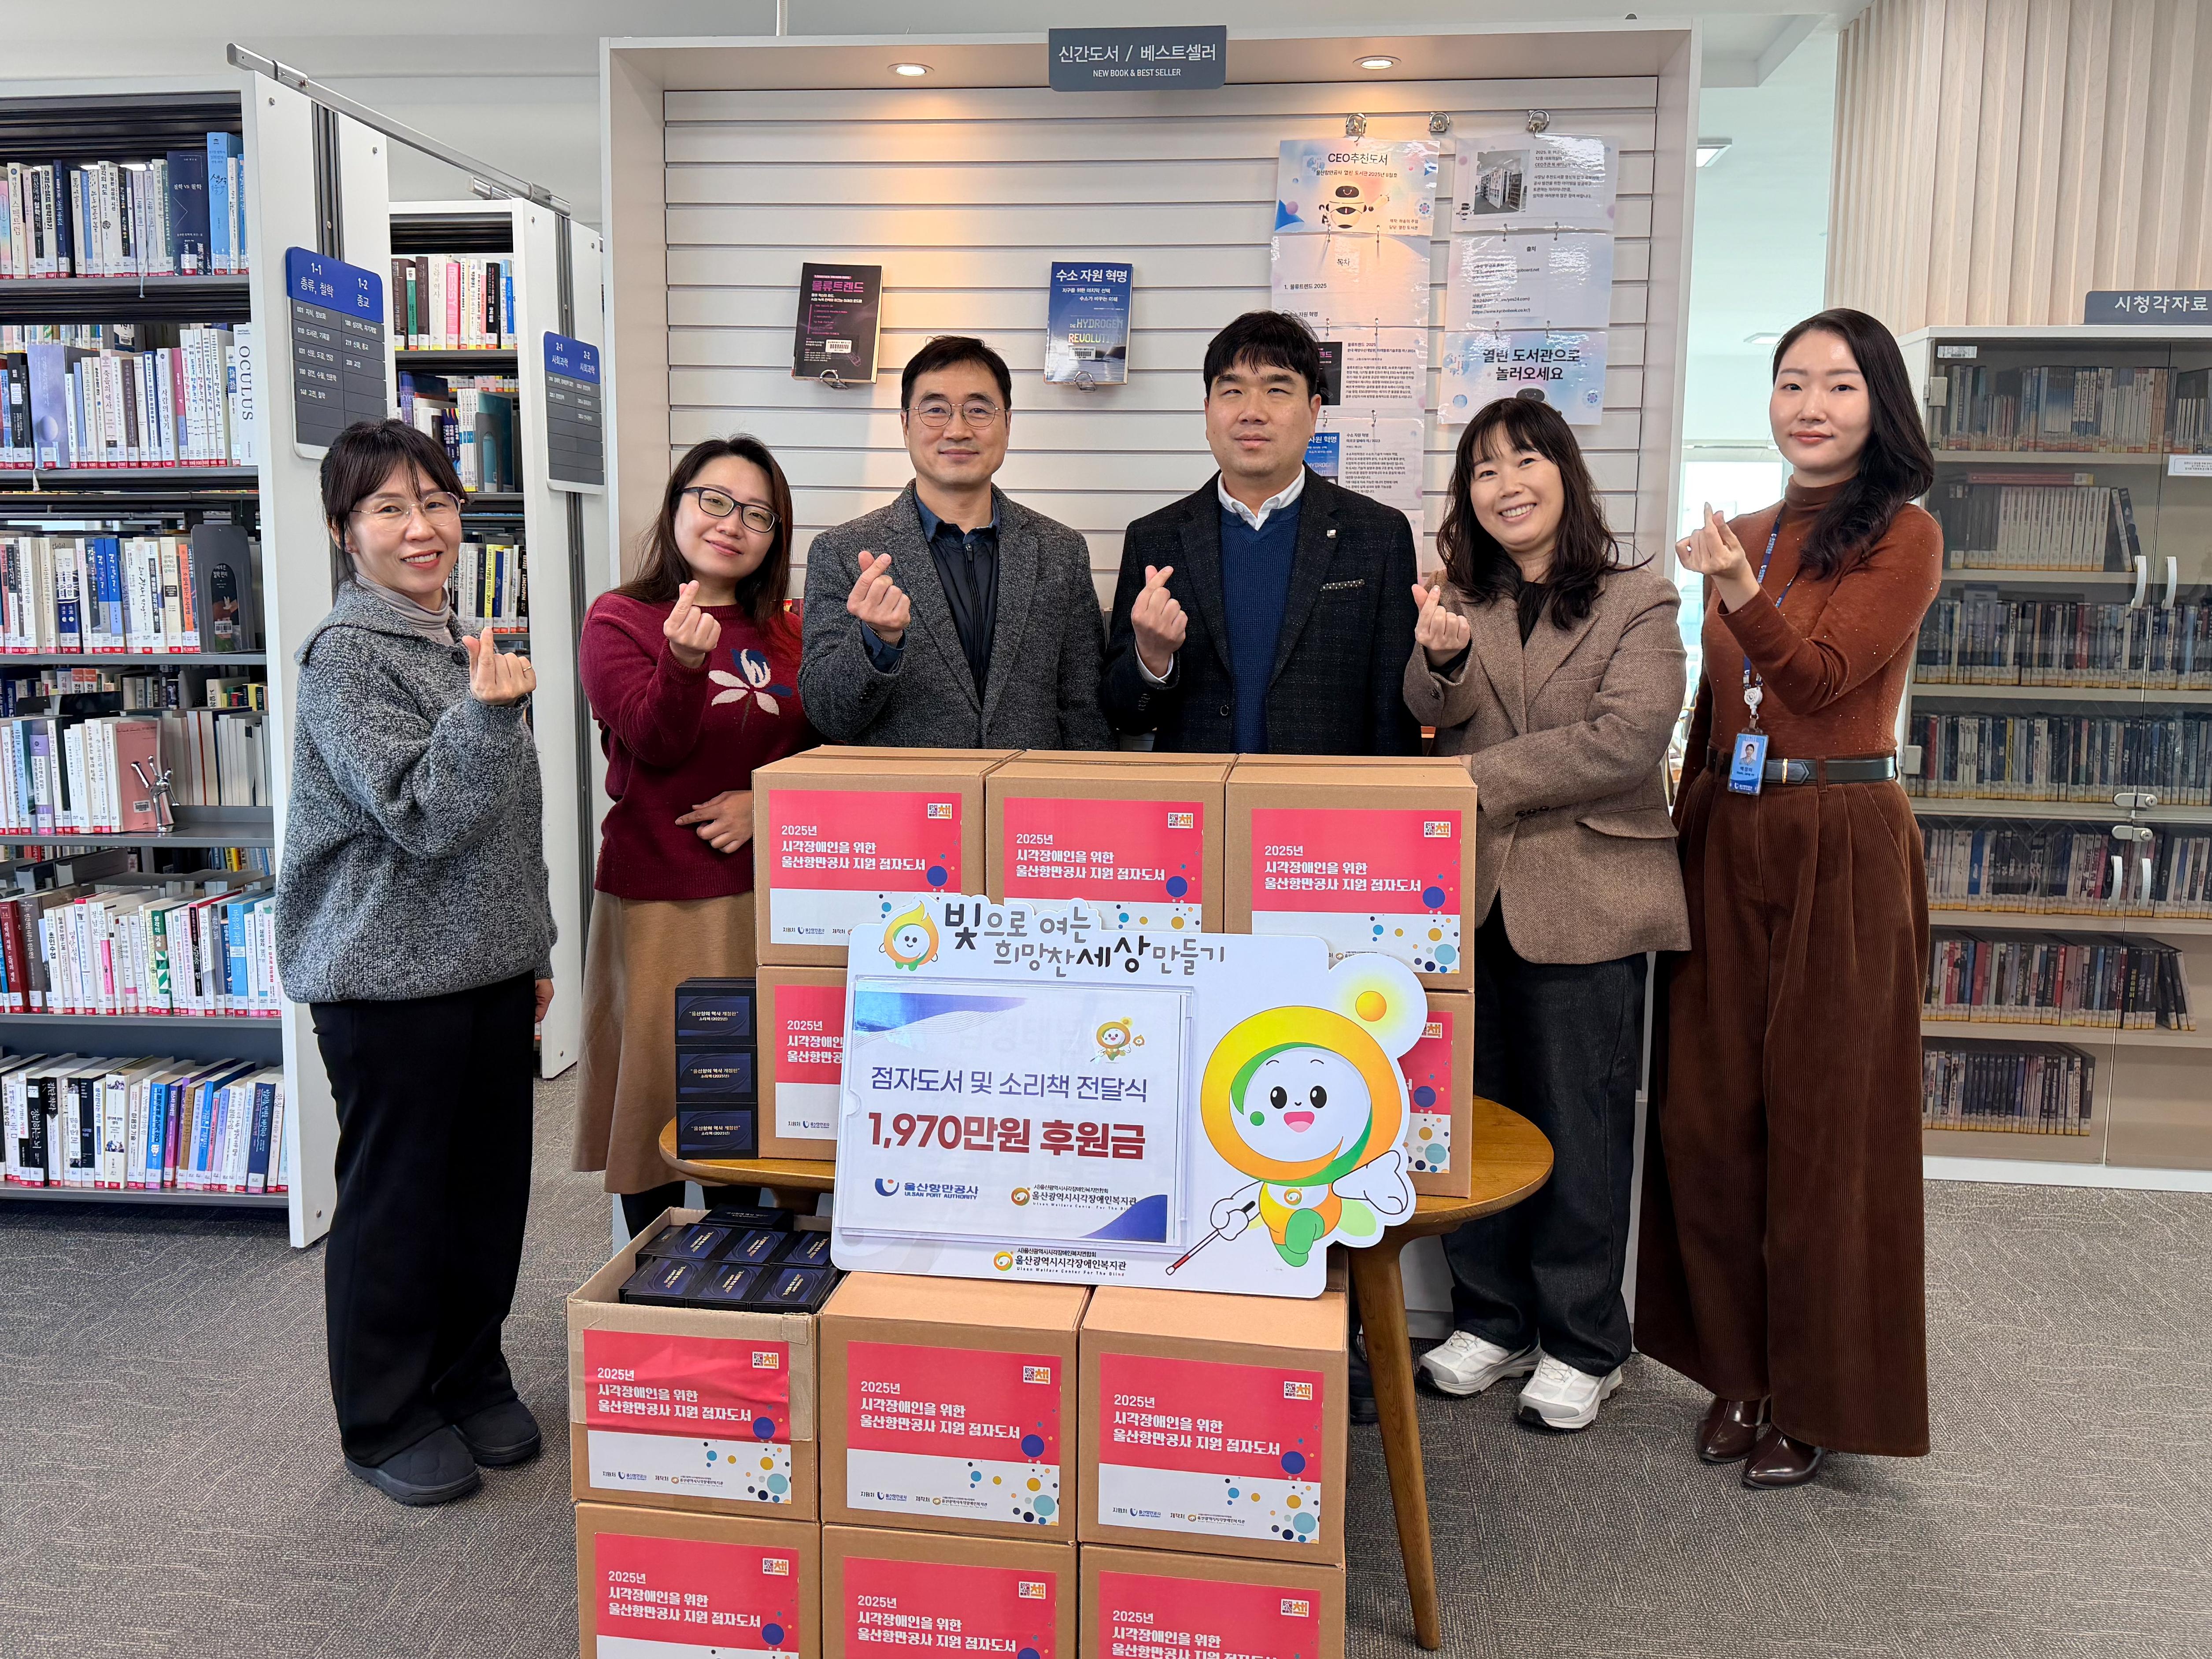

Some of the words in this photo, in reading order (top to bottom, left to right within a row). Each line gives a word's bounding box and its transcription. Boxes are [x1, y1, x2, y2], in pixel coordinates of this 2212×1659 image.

[1058, 45, 1119, 63] 신간도서
[1125, 45, 1133, 62] /
[1140, 44, 1216, 62] 베스트셀러
[1328, 153, 1388, 165] CEO추천도서
[311, 262, 322, 275] 1-1
[1056, 270, 1078, 282] 수소
[1080, 270, 1102, 282] 자원
[1106, 270, 1127, 283] 혁명
[320, 282, 333, 298] 철학
[358, 278, 368, 290] 1-2
[812, 281, 863, 292] 물류트렌드
[357, 294, 370, 307] 종교
[2114, 296, 2208, 314] 시청각자료
[1076, 318, 1123, 329] HYDROGEN
[552, 355, 568, 368] 사회과학
[1483, 349, 1508, 363] 열린
[1512, 349, 1580, 362] 도서관으로
[580, 363, 595, 375] 사회과학
[1496, 366, 1563, 381] 놀러오세요
[239, 346, 253, 420] OCULUS
[781, 825, 817, 835] 2025년
[1016, 834, 1053, 845] 2025년
[781, 840, 850, 854] 시각장애인을
[853, 841, 877, 854] 위한
[1265, 846, 1303, 856] 2025년
[781, 856, 850, 869] 울산항만공사
[853, 857, 876, 870] 지원
[879, 858, 926, 871] 점자도서
[1016, 849, 1087, 863] 시각장애인을
[1090, 851, 1114, 864] 위한
[1016, 865, 1087, 879] 울산항만공사
[1090, 867, 1113, 879] 지원
[1117, 868, 1165, 881] 점자도서
[1265, 861, 1339, 875] 시각장애인을
[1343, 862, 1368, 875] 위한
[1265, 877, 1339, 890] 울산항만공사
[1342, 878, 1367, 891] 지원
[1370, 879, 1421, 892] 점자도서
[945, 903, 1028, 950] 빛으로
[1040, 906, 1091, 944] 여는
[233, 931, 241, 945] 과학
[787, 1020, 823, 1031] 2025년
[871, 1066, 963, 1094] 점자도서
[971, 1072, 991, 1095] 및
[999, 1073, 1069, 1099] 소리책
[1076, 1075, 1147, 1102] 전달식
[31, 1108, 40, 1139] 정리하는
[131, 1131, 137, 1141] 기술
[869, 1112, 1030, 1153] 1,970만원
[1040, 1119, 1145, 1160] 후원금
[33, 1140, 41, 1149] 뇌
[904, 1182, 979, 1195] 울산항만공사
[1032, 1191, 1137, 1205] 울산광역시시각장애인복지관
[1015, 1256, 1126, 1271] 울산광역시시각장애인복지관
[598, 1368, 634, 1382] 2025년
[598, 1384, 670, 1399] 시각장애인을
[673, 1389, 698, 1402] 위한
[861, 1381, 900, 1394] 2025년
[861, 1398, 936, 1416] 시각장애인을
[940, 1404, 966, 1418] 위한
[1114, 1394, 1155, 1409] 2025년
[598, 1400, 670, 1416] 울산항만공사
[674, 1405, 698, 1419] 지원
[702, 1407, 751, 1422] 점자도서
[860, 1415, 936, 1433] 울산항만공사
[940, 1421, 965, 1435] 지원
[969, 1423, 1020, 1439] 점자도서
[1113, 1411, 1193, 1430] 시각장애인을
[1196, 1418, 1223, 1434] 위한
[1113, 1429, 1192, 1448] 울산항만공사
[1196, 1435, 1222, 1451] 지원
[1226, 1438, 1280, 1455] 점자도서
[608, 1571, 646, 1584] 2025년
[608, 1587, 681, 1605] 시각장애인을
[684, 1593, 709, 1607] 위한
[858, 1595, 897, 1609] 2025년
[608, 1603, 681, 1621] 울산항만공사
[684, 1609, 708, 1624] 지원
[712, 1611, 761, 1627] 점자도서
[858, 1611, 933, 1630] 시각장애인을
[936, 1617, 962, 1632] 위한
[1113, 1611, 1154, 1624] 2025년
[858, 1628, 932, 1646] 울산항만공사
[936, 1634, 961, 1649] 지원
[965, 1636, 1016, 1652] 점자도서
[1113, 1626, 1191, 1646] 시각장애인을
[1195, 1633, 1221, 1648] 위한
